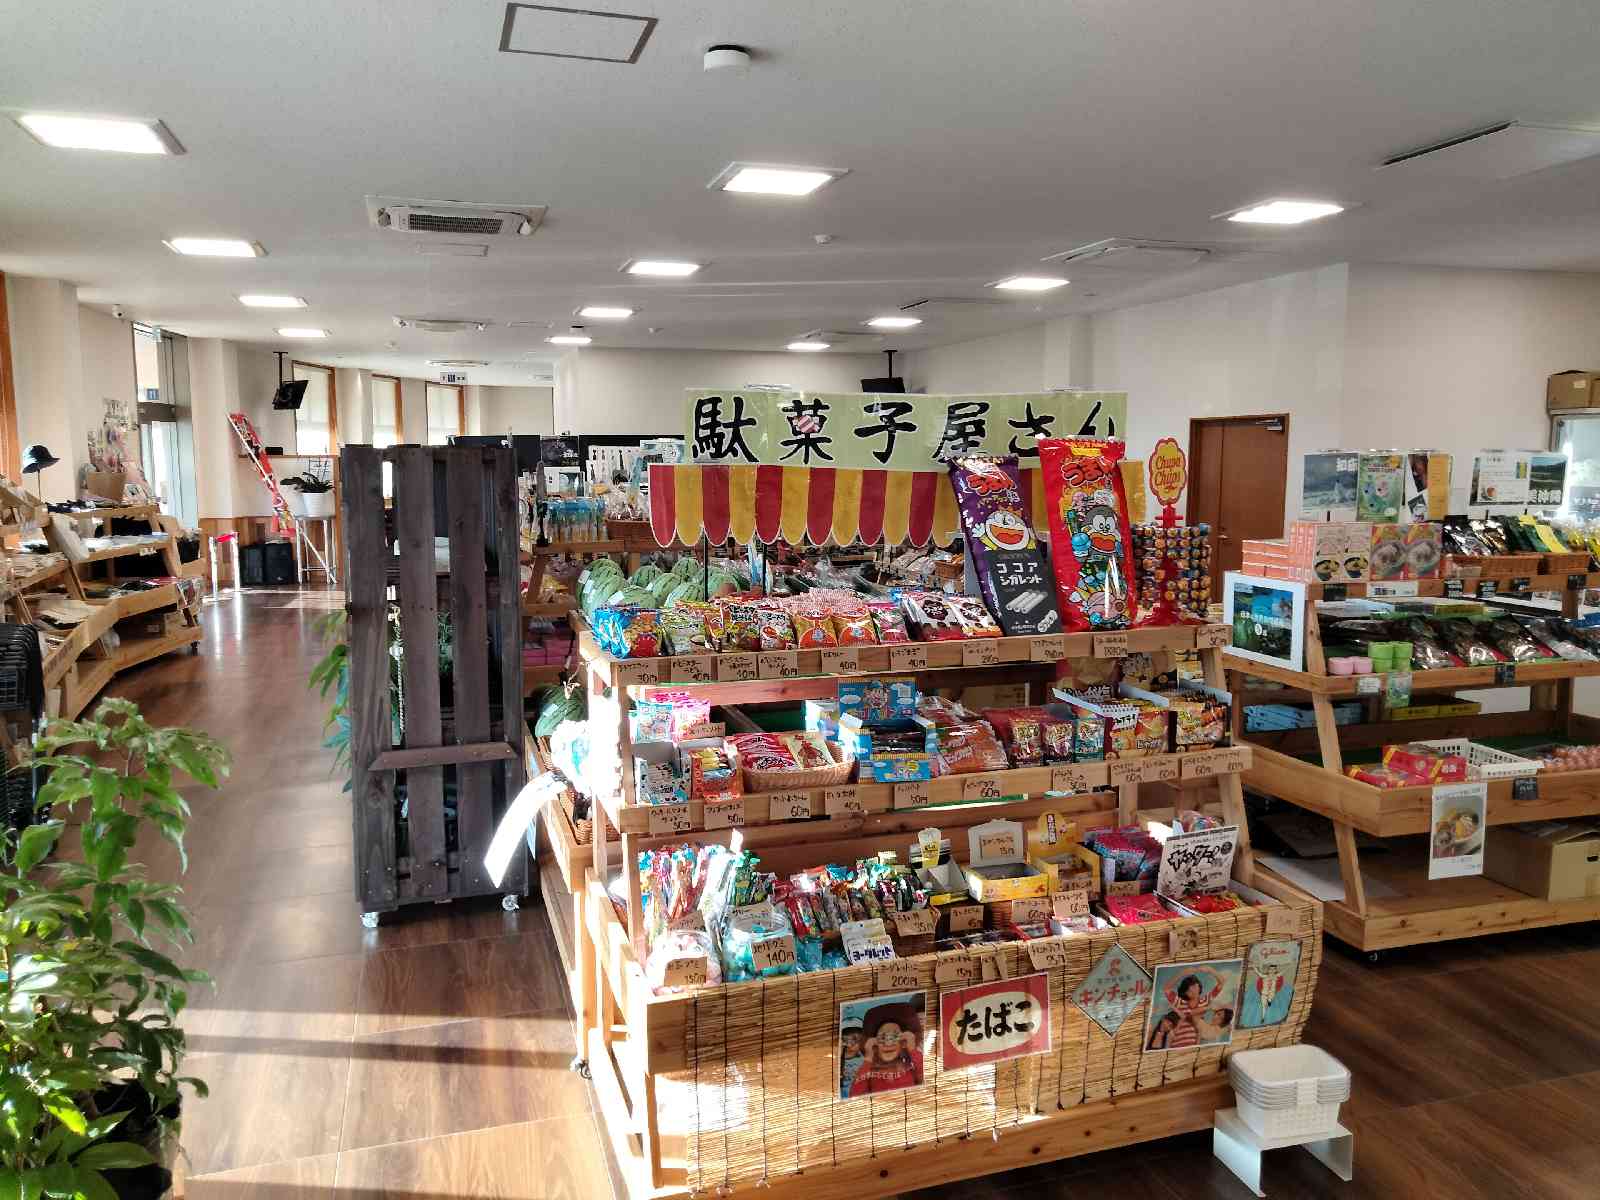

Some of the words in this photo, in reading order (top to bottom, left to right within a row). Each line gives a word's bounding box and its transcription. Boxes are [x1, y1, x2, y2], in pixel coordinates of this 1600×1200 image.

[1155, 455, 1182, 469] Chupa
[1154, 470, 1182, 486] Chups
[996, 561, 1038, 574] ココア
[767, 949, 796, 967] 140円
[955, 999, 1036, 1046] たばこ
